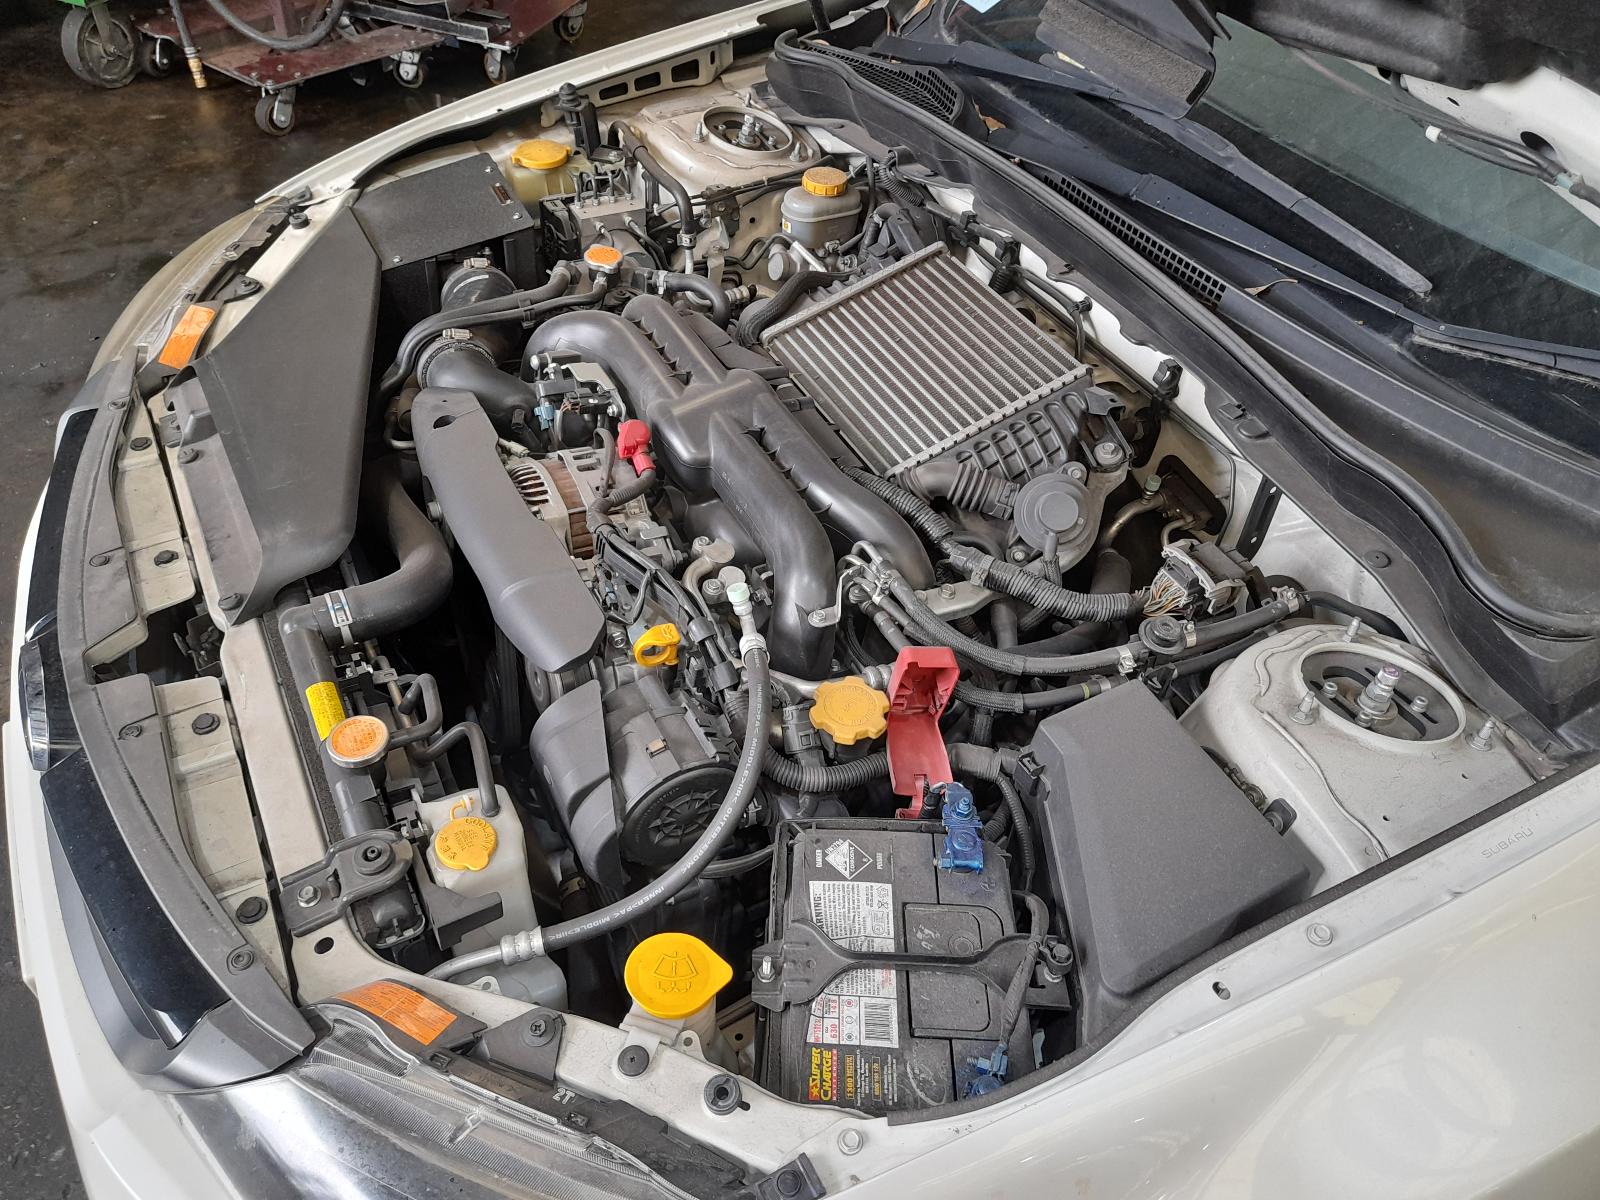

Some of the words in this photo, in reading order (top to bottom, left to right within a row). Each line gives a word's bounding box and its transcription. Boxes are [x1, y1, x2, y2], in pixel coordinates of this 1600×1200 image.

[1480, 827, 1534, 859] SUBARU
[813, 893, 825, 930] ARNING:
[830, 1023, 838, 1039] 630
[809, 1047, 820, 1087] SUPER
[821, 1049, 831, 1100] CHARGE
[552, 1087, 576, 1105] 2T
